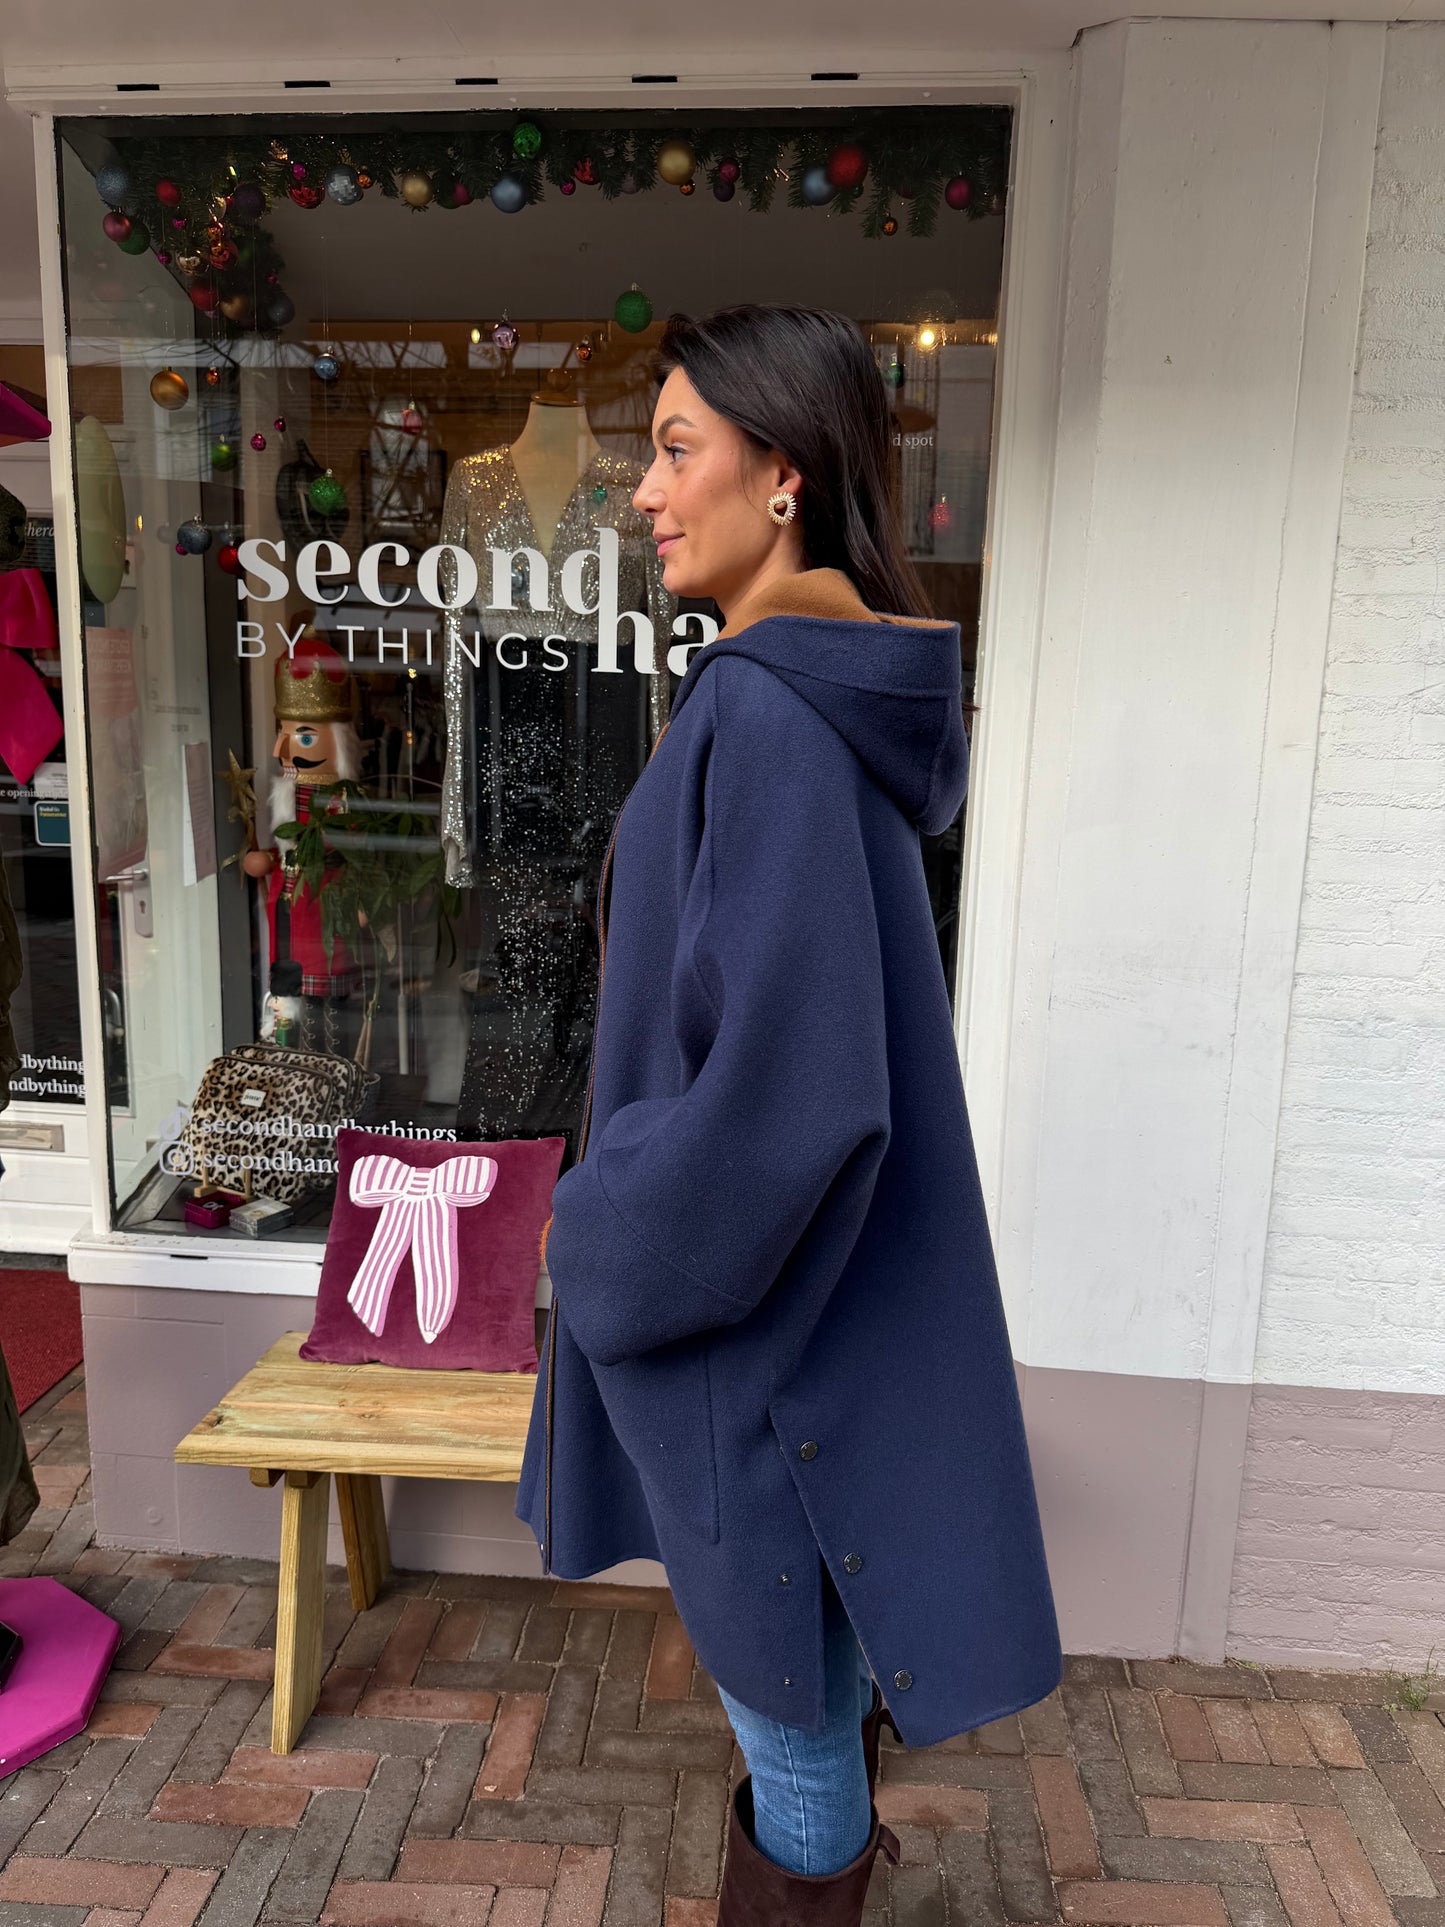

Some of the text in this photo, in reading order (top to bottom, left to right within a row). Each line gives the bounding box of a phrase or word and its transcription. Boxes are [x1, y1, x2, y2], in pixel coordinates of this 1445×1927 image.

[905, 436, 934, 449] spot
[237, 527, 619, 615] second
[237, 621, 569, 673] BY THINGS
